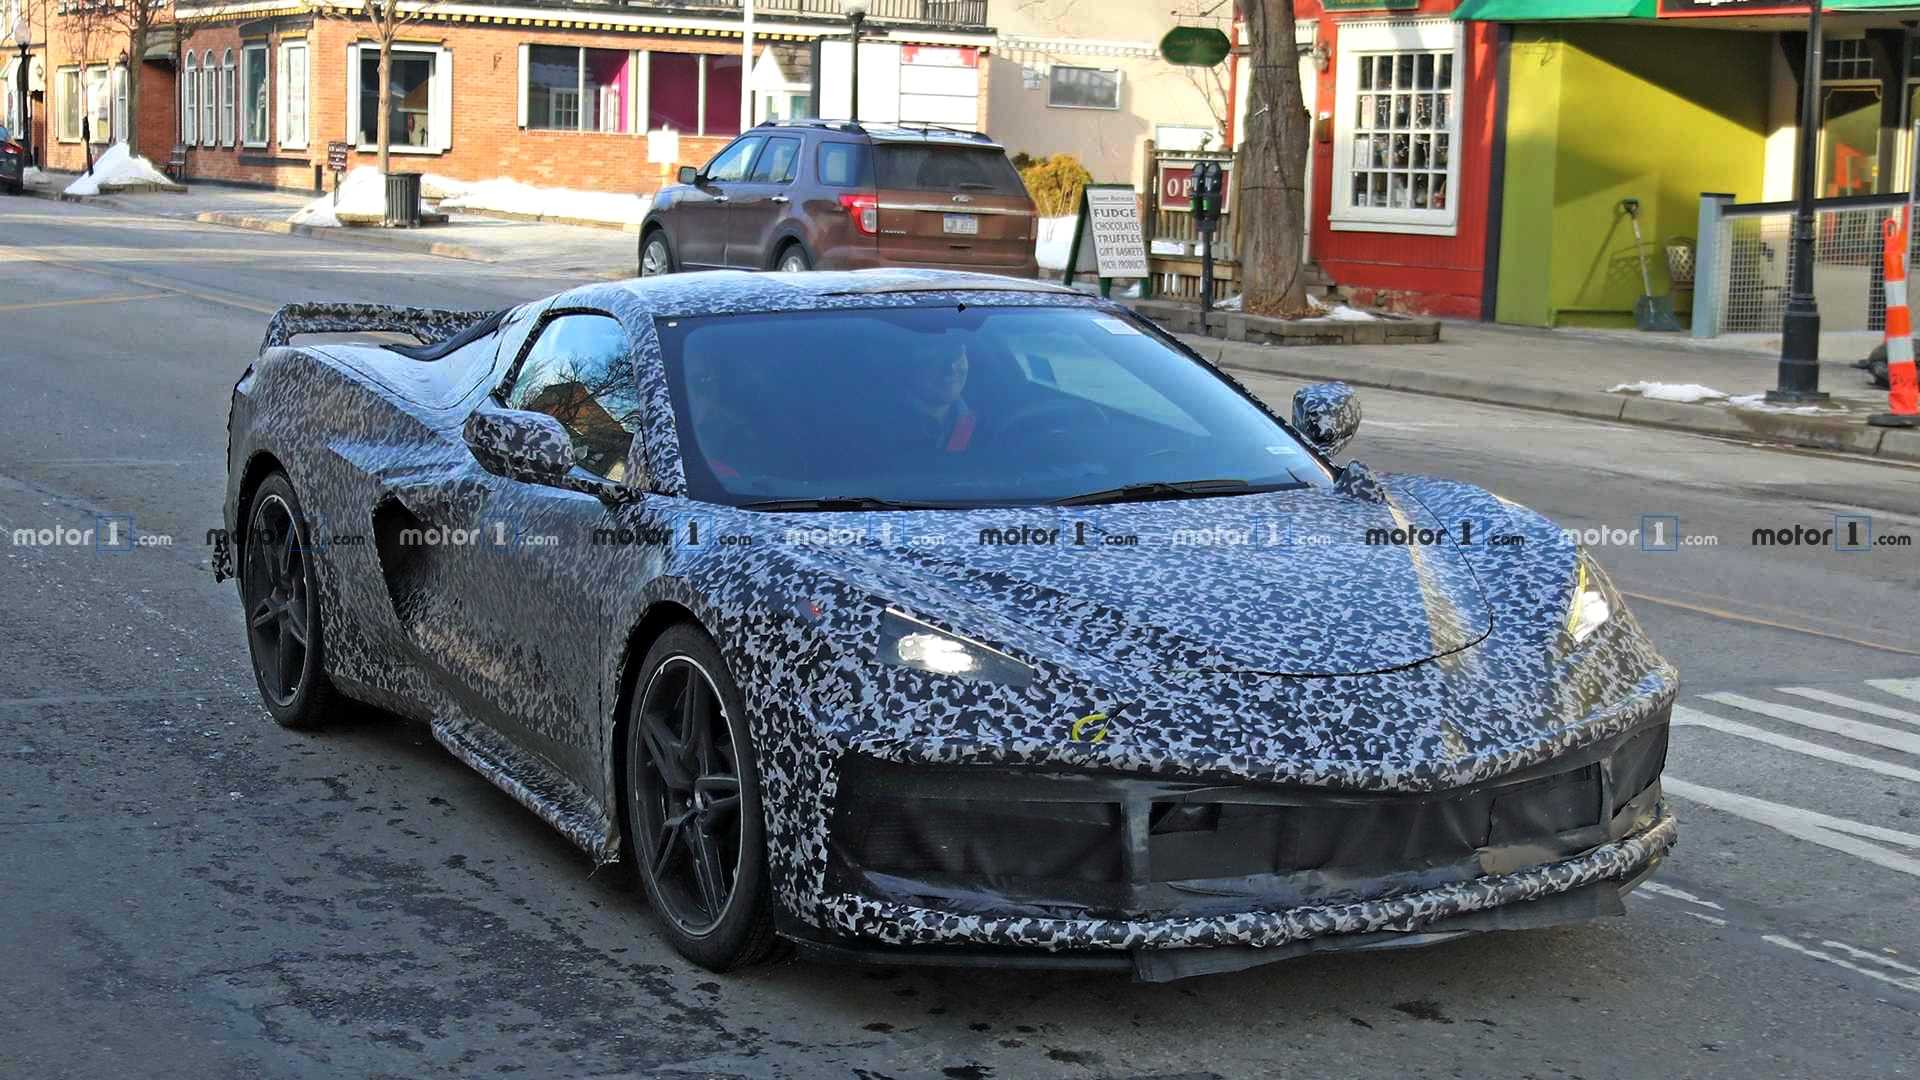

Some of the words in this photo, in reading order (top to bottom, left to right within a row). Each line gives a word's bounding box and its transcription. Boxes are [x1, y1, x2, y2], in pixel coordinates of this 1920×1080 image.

[1167, 178, 1192, 197] OP
[1094, 208, 1136, 218] FUDGE
[1095, 221, 1140, 231] CHOCOLATES
[1097, 234, 1141, 243] TRUFFLES
